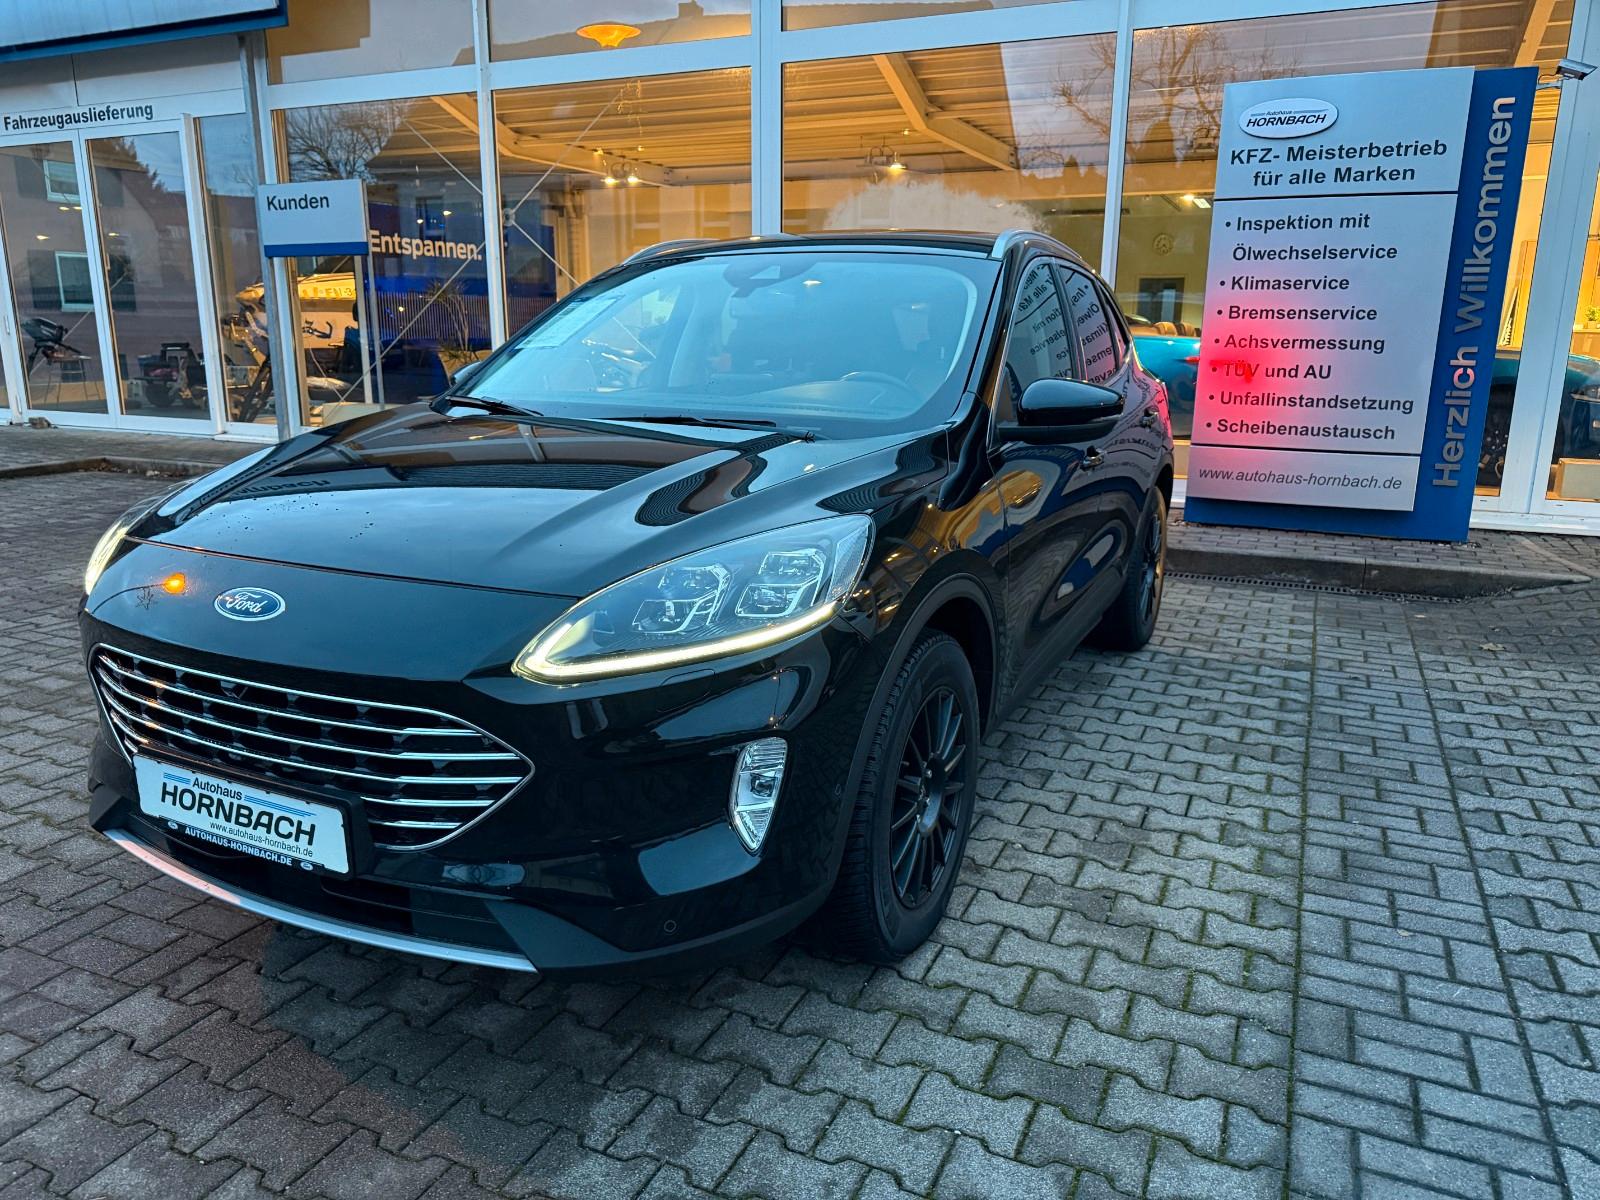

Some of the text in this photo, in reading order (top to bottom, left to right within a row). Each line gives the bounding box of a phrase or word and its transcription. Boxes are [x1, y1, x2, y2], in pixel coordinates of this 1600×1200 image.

[3, 102, 154, 131] Fahrzeugauslieferung
[1246, 114, 1327, 128] HORNBACH
[1230, 140, 1447, 165] KFZ- Meisterbetrieb
[1253, 165, 1415, 187] für alle Marken
[265, 193, 330, 212] Kunden
[1236, 213, 1370, 233] Inspektion mit
[369, 229, 482, 261] Entspannen.
[1232, 243, 1398, 261] Ölwechselservice
[1231, 275, 1350, 290] Klimaservice
[1432, 96, 1516, 488] Herzlich Willkommen
[1228, 305, 1378, 321] Bremsenservice
[1224, 334, 1386, 354] Achsvermessung
[1223, 360, 1332, 379] TÜV und AU
[1219, 390, 1414, 414] Unfallinstandsetzung
[1217, 418, 1396, 440] Scheibenaustausch
[1199, 468, 1403, 490] www.autohaus-hornbach.de
[225, 591, 269, 613] Ford
[192, 777, 243, 800] Autohaus
[160, 782, 316, 846] HORNBACH
[184, 827, 293, 866] AUTOHAUS-HORNBACH.DE
[209, 821, 314, 857] www.autohaus-hornbach.de
